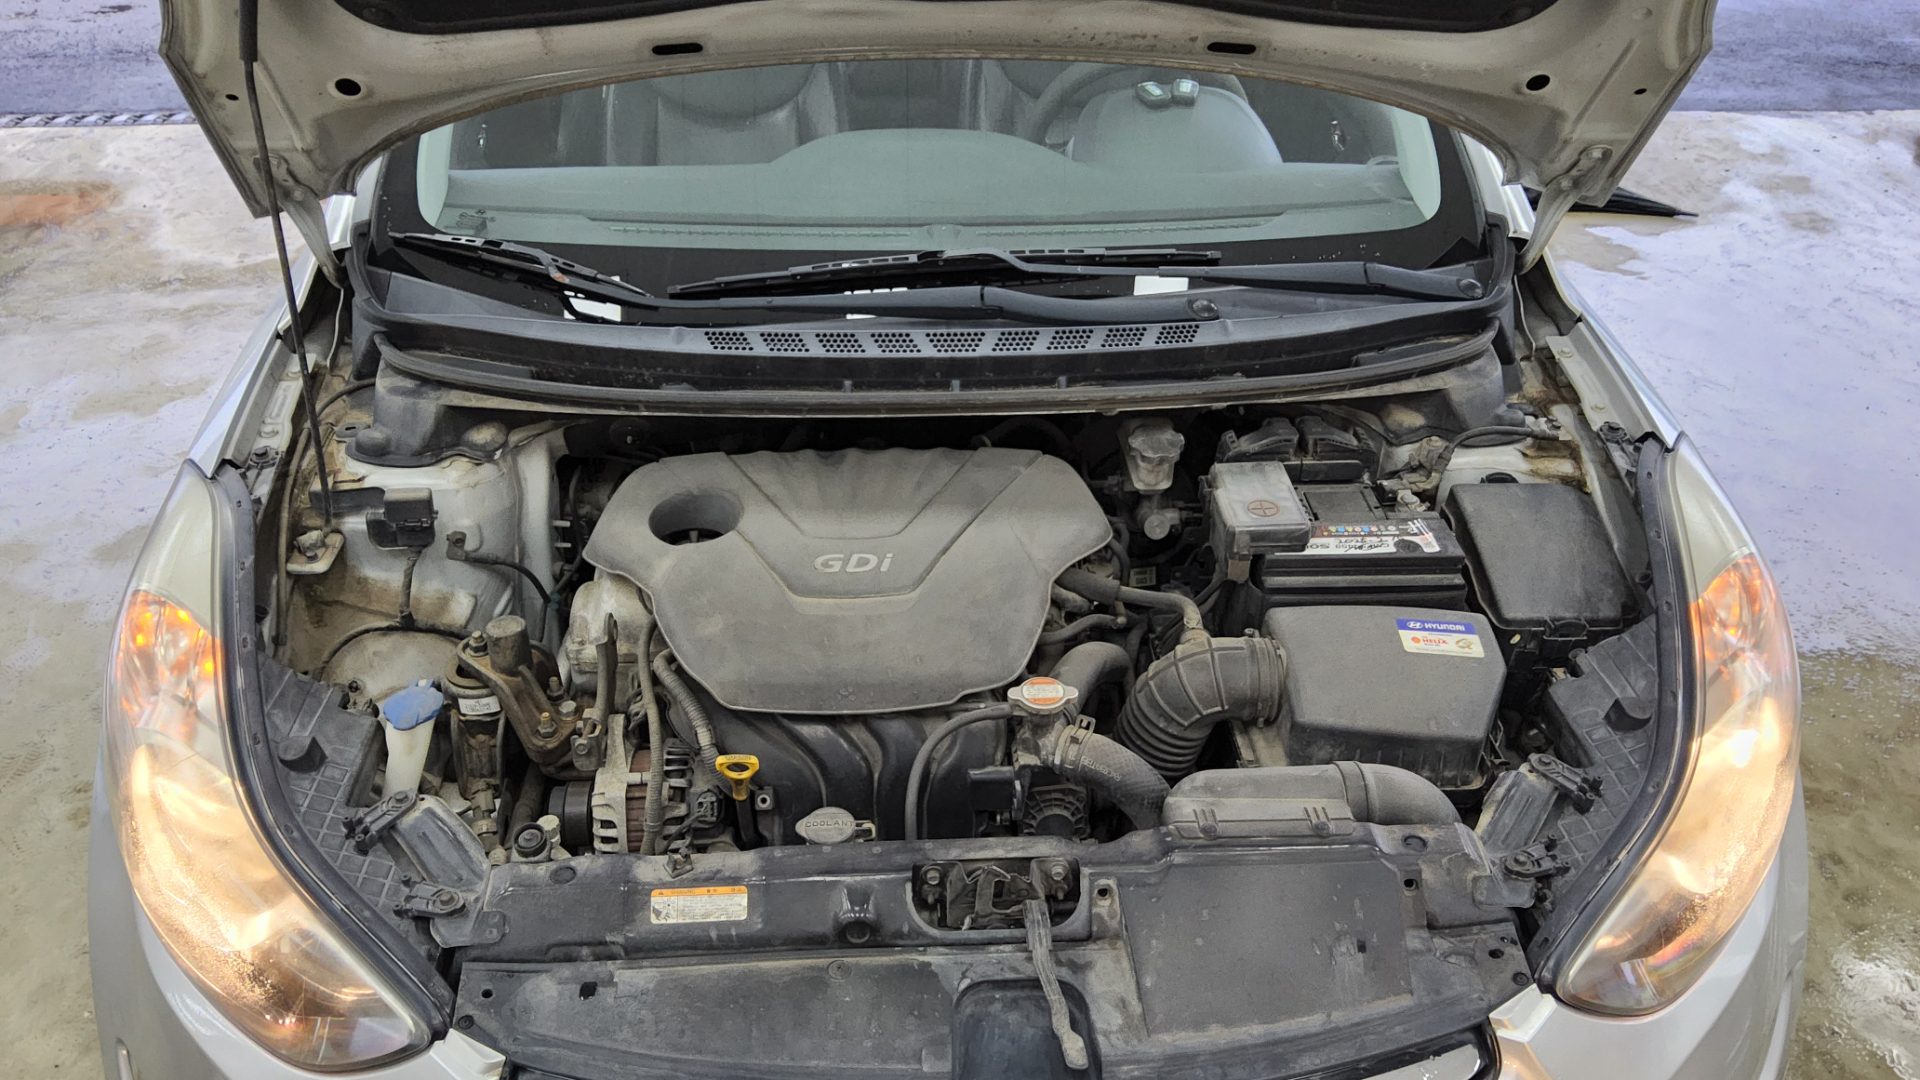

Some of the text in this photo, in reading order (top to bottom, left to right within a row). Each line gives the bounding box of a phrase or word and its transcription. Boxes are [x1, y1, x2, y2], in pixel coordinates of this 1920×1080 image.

[814, 553, 894, 572] GDi
[1424, 623, 1465, 631] HYUNDAI
[805, 820, 853, 828] COOLANT
